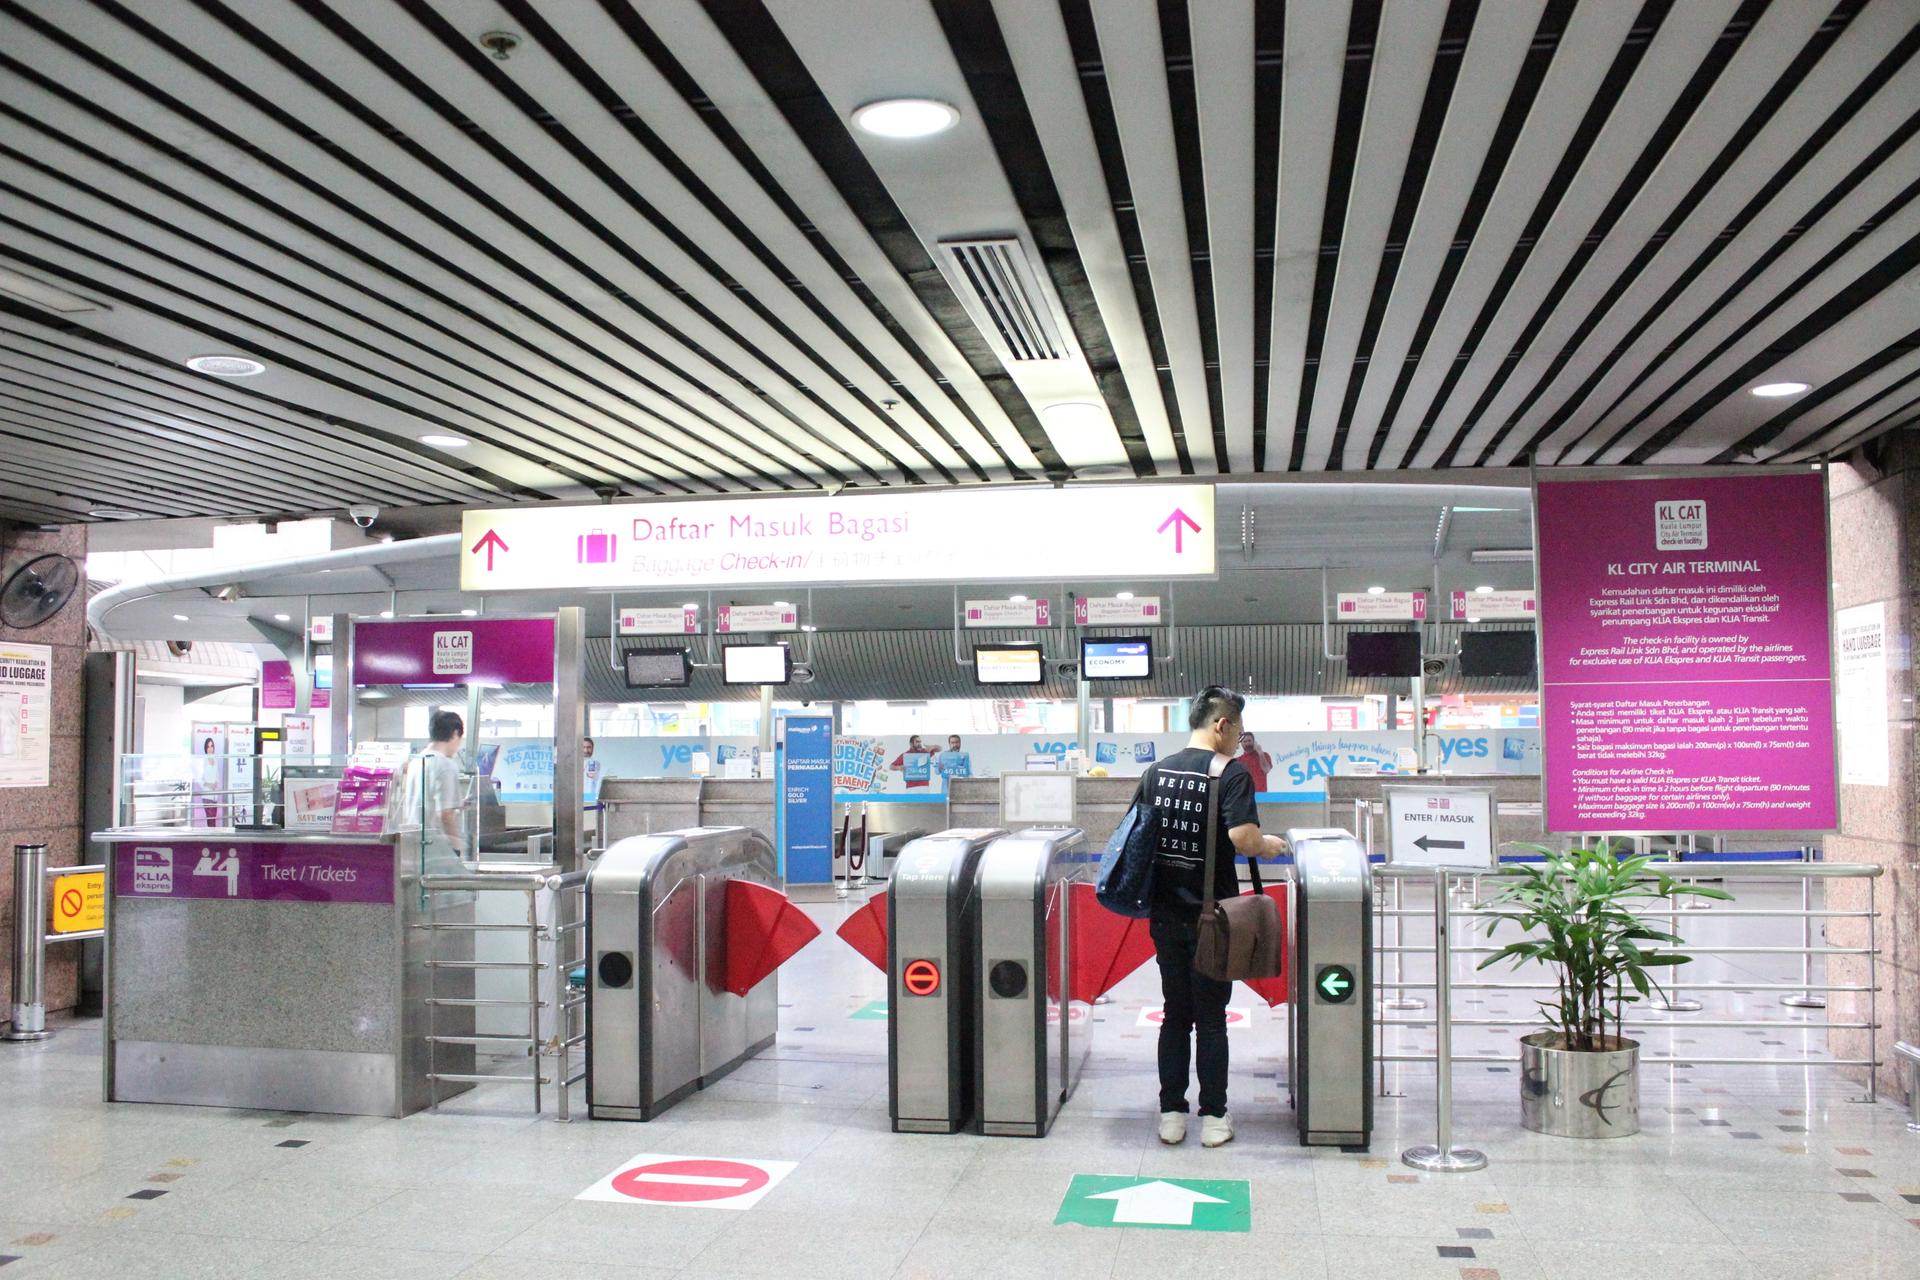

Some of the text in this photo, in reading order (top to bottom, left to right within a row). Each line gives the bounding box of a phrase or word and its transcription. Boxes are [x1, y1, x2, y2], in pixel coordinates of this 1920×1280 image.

[1660, 505, 1701, 520] KL CAT
[633, 512, 908, 541] Daftar Masuk Bagasi
[1684, 537, 1702, 545] facility
[632, 555, 714, 576] Baggage
[1608, 560, 1760, 575] KL CITY AIR TERMINAL
[1601, 584, 1766, 596] Kemudahan daftar masuk ini dimiliki oleh
[1414, 599, 1424, 612] 17
[1454, 598, 1465, 611] 18
[1589, 594, 1779, 608] Express Rail Link Sdn Bhd, dan dikendalikan oleh
[1037, 605, 1048, 618] 15
[1076, 604, 1087, 617] 16
[1590, 604, 1778, 618] syarikat penerbangan untuk kegunaan eksklusif
[685, 614, 695, 626] 13
[720, 613, 729, 625] 14
[1602, 614, 1769, 627] penumpang KLIA Ekspres dan KLIA Transit.
[437, 636, 468, 648] KL CAT
[1623, 634, 1748, 645] The check-in facility is owned by
[1580, 643, 1792, 657] Express Rail Link Sdn Bhd, and operated by the airlines
[1569, 657, 1580, 665] for
[1582, 656, 1616, 665] exclusive
[1633, 656, 1642, 664] of
[1644, 656, 1662, 664] KLIA
[1664, 655, 1693, 666] Ekspres
[1695, 655, 1711, 663] and
[1712, 654, 1731, 663] KLIA
[1734, 654, 1759, 662] Transit
[1761, 654, 1806, 664] passengers.
[9, 666, 46, 680] LUGGAGE
[1663, 699, 1709, 709] Penerbangan
[834, 744, 873, 767] UBLE
[1276, 746, 1309, 764] Amazing
[1312, 741, 1336, 753] things
[1338, 738, 1369, 752] happen
[1371, 743, 1390, 755] when
[1440, 737, 1488, 764] yes
[504, 753, 522, 765] YES
[834, 759, 875, 782] UBLE
[1288, 755, 1338, 786] SAY
[834, 775, 870, 791] TEMENT
[1158, 777, 1207, 793] NEIGH
[1404, 813, 1433, 822] ENTER
[1440, 814, 1474, 823] MASUK
[1162, 818, 1199, 833] DAND
[1161, 838, 1199, 852] ZZUE
[136, 872, 171, 882] KLIA
[261, 864, 357, 882] Tiket / Tickets
[902, 873, 944, 882] Tap Here
[1311, 875, 1358, 884] Tap Here
[136, 882, 170, 890] ekspres
